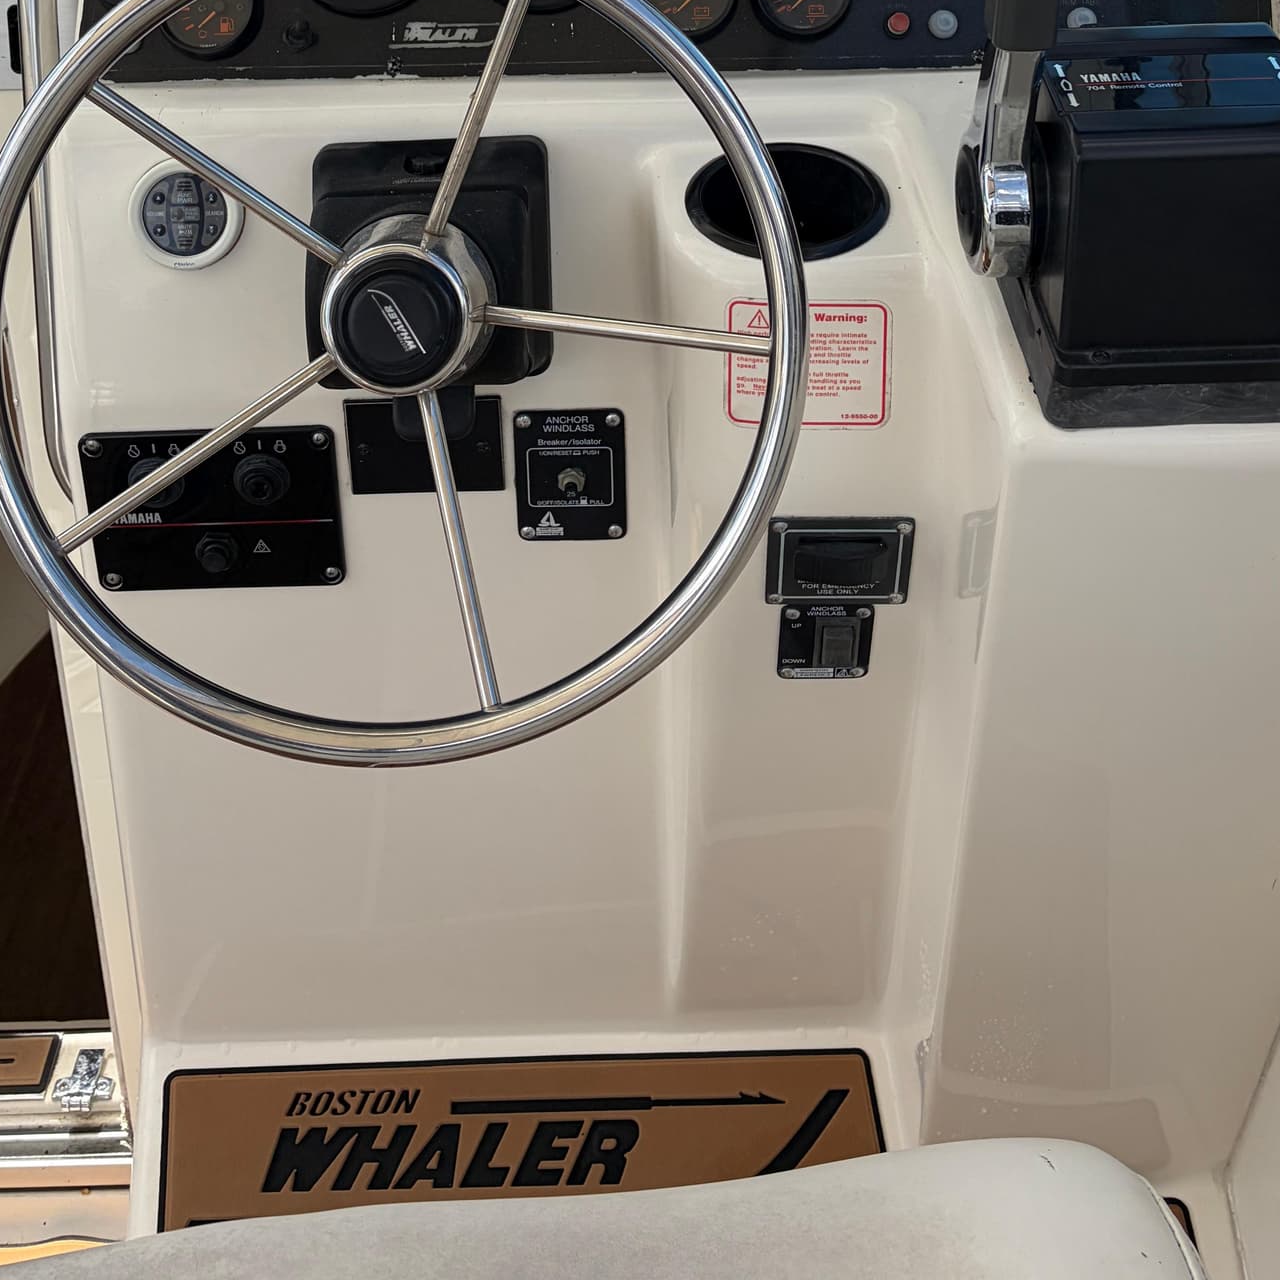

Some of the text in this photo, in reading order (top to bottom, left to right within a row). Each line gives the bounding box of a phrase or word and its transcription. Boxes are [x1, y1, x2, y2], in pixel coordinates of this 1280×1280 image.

[1080, 72, 1141, 83] YAMAHA
[814, 312, 868, 323] Warning:
[383, 305, 417, 351] WHALER
[737, 356, 763, 364] changes
[545, 415, 589, 424] ANCHOR
[542, 424, 595, 432] WINDLASS
[114, 512, 162, 524] AMAHA
[286, 1088, 422, 1118] BOSTON
[260, 1118, 640, 1193] WHALER
